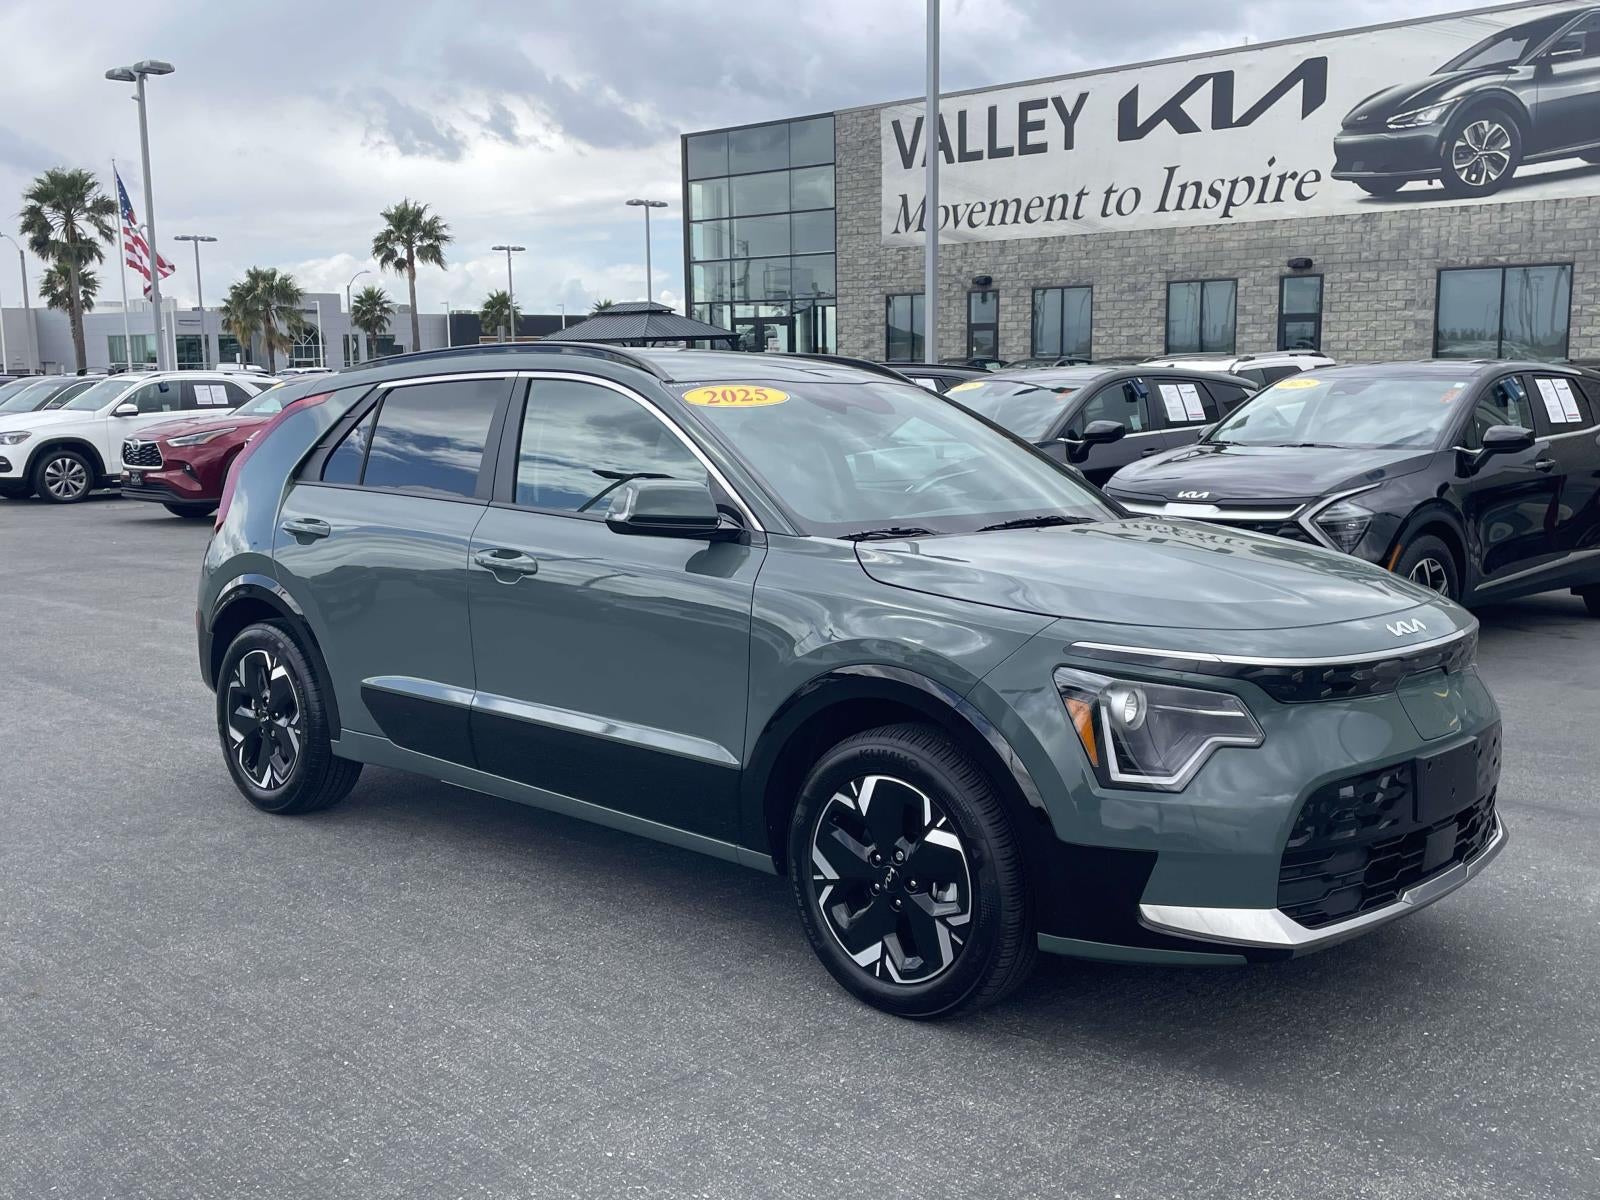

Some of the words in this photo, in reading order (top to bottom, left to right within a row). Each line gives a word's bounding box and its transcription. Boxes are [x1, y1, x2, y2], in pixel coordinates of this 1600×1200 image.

[891, 91, 1089, 170] VALLEY
[1117, 56, 1328, 142] KIA
[1100, 181, 1141, 218] to
[1153, 155, 1322, 219] Inspire
[703, 388, 769, 404] 2025
